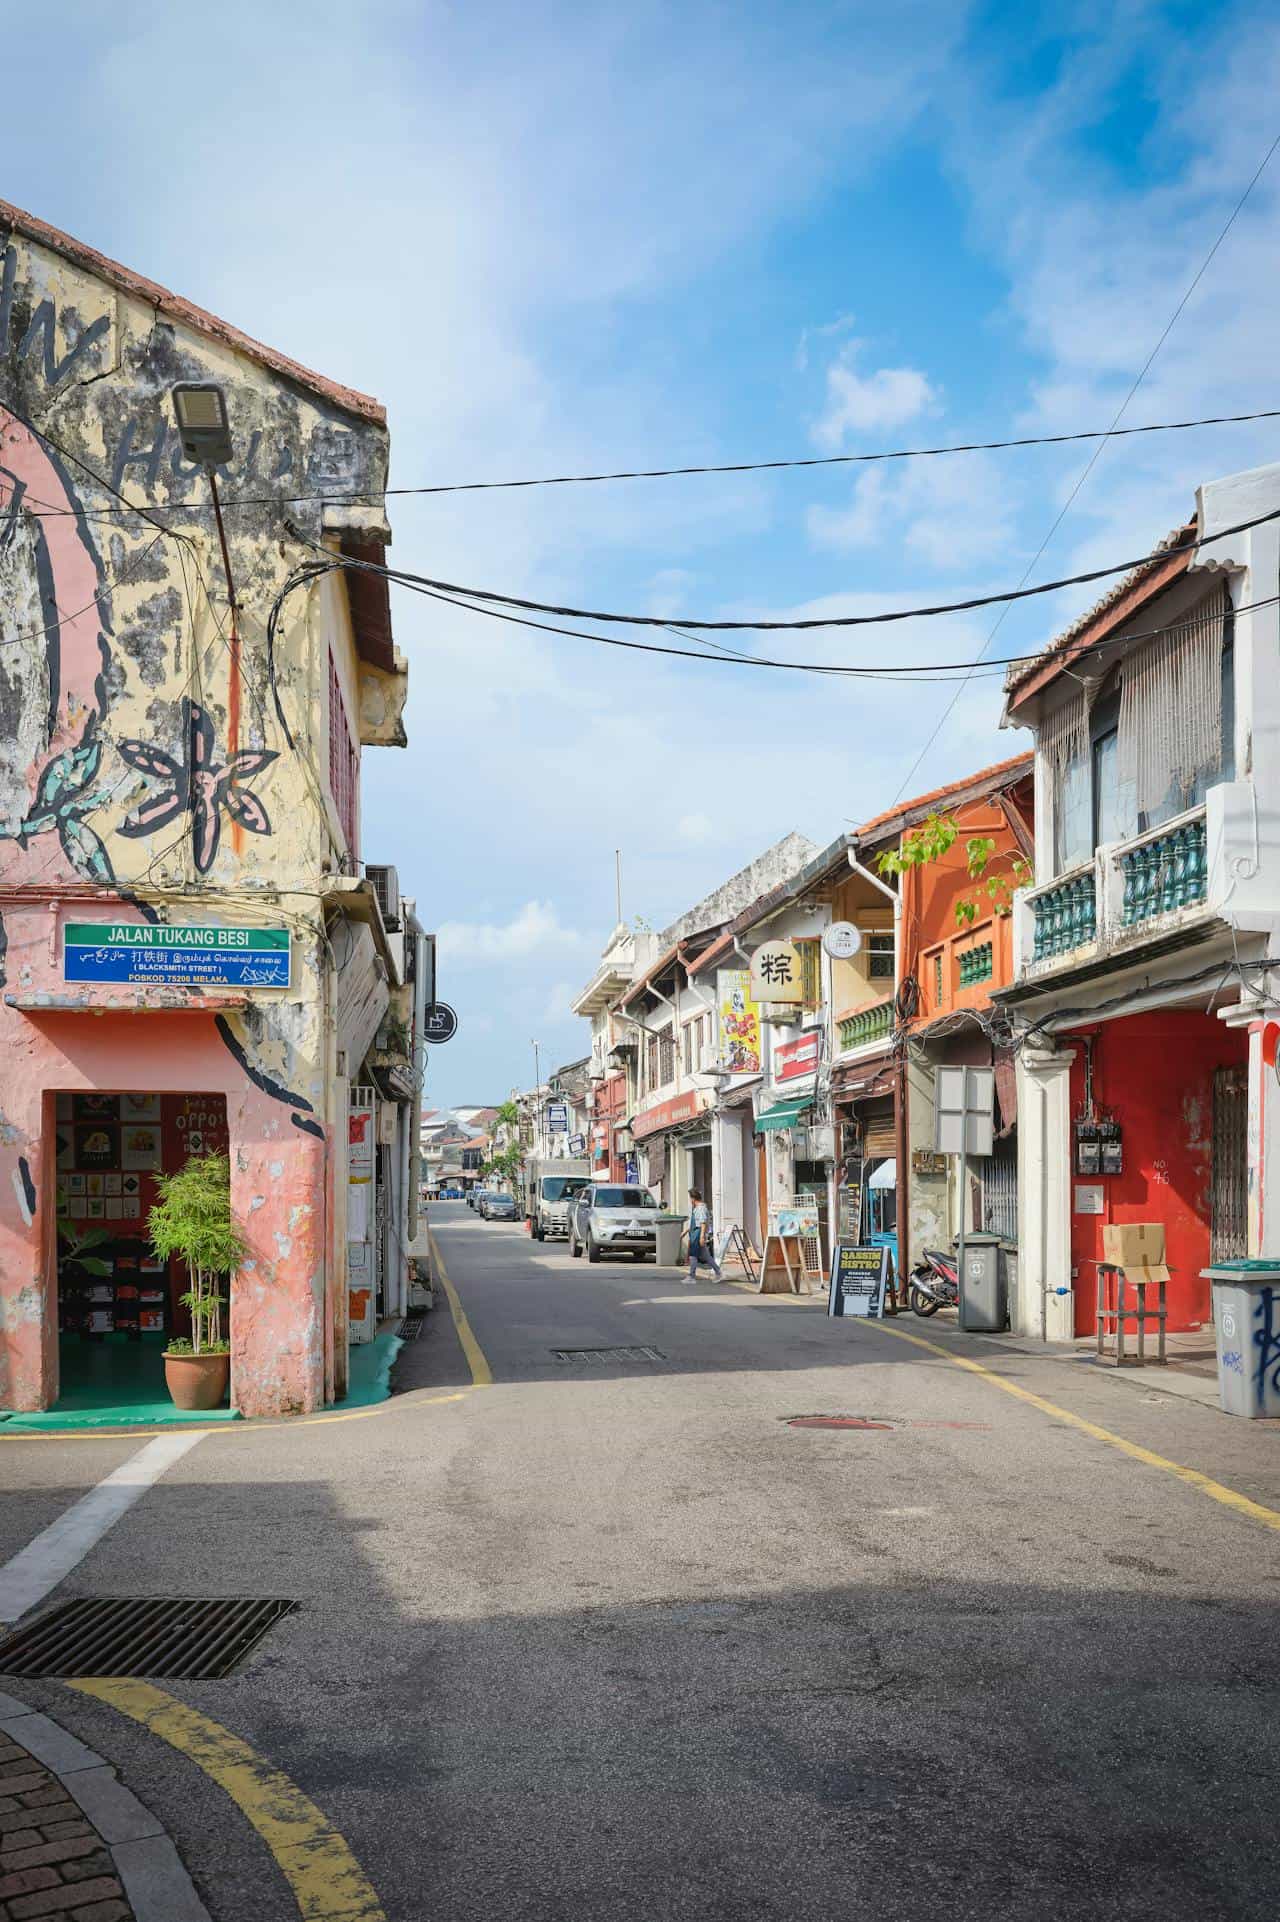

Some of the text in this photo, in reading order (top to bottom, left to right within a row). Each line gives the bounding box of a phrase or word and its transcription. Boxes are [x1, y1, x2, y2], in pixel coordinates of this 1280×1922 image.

[107, 927, 249, 946] JALAN TUKANG BESI
[130, 950, 168, 964] 打铁街
[188, 964, 217, 973] STREET
[761, 953, 793, 986] 粽
[128, 973, 165, 982] POSKOD
[193, 975, 228, 984] MELAKA
[840, 1260, 880, 1269] BISTRO
